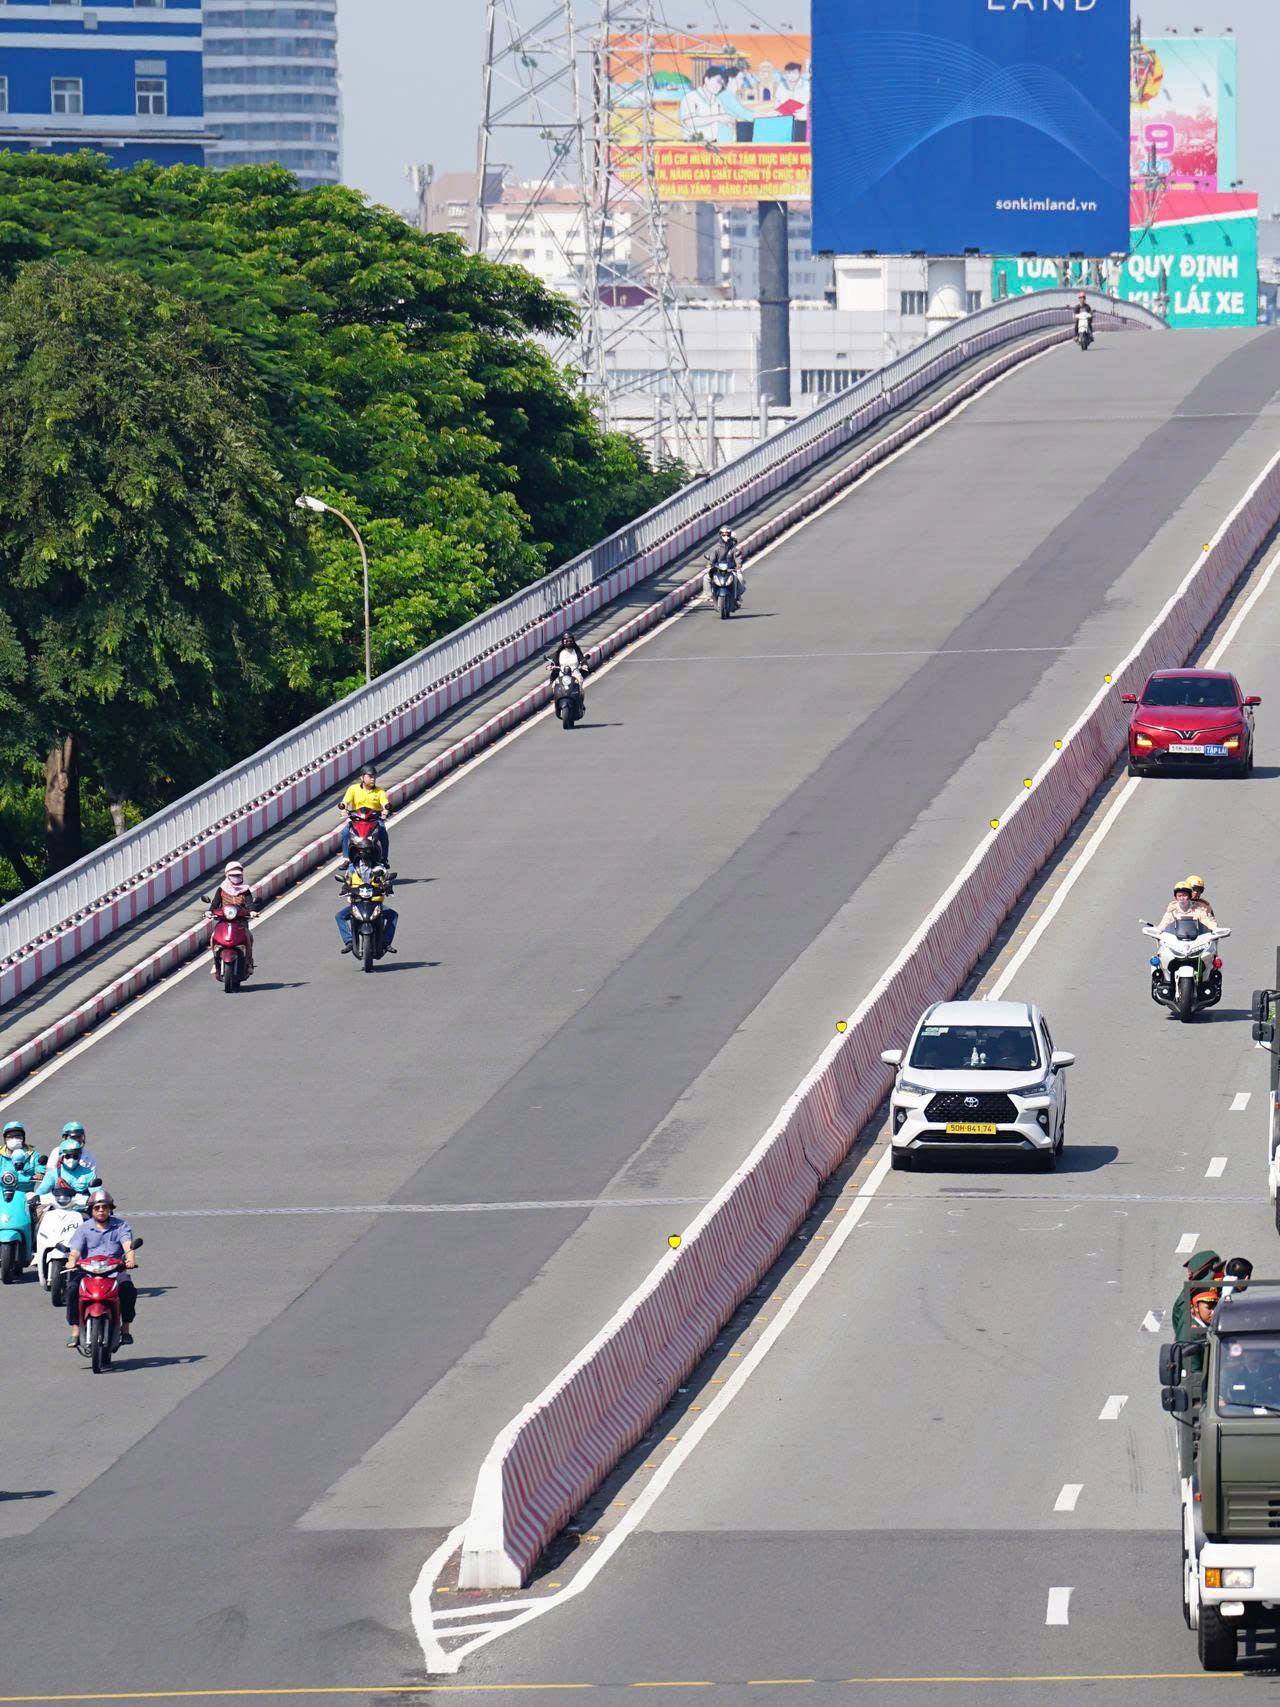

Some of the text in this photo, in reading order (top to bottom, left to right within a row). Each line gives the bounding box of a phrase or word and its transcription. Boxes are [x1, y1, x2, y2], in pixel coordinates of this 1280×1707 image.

[987, 0, 1097, 11] LAND
[996, 197, 1096, 211] sonkimland.vn
[1128, 255, 1174, 282] QUY
[1179, 255, 1239, 283] ĐỊNH
[1175, 284, 1211, 314] LÁI
[1216, 291, 1245, 314] XE
